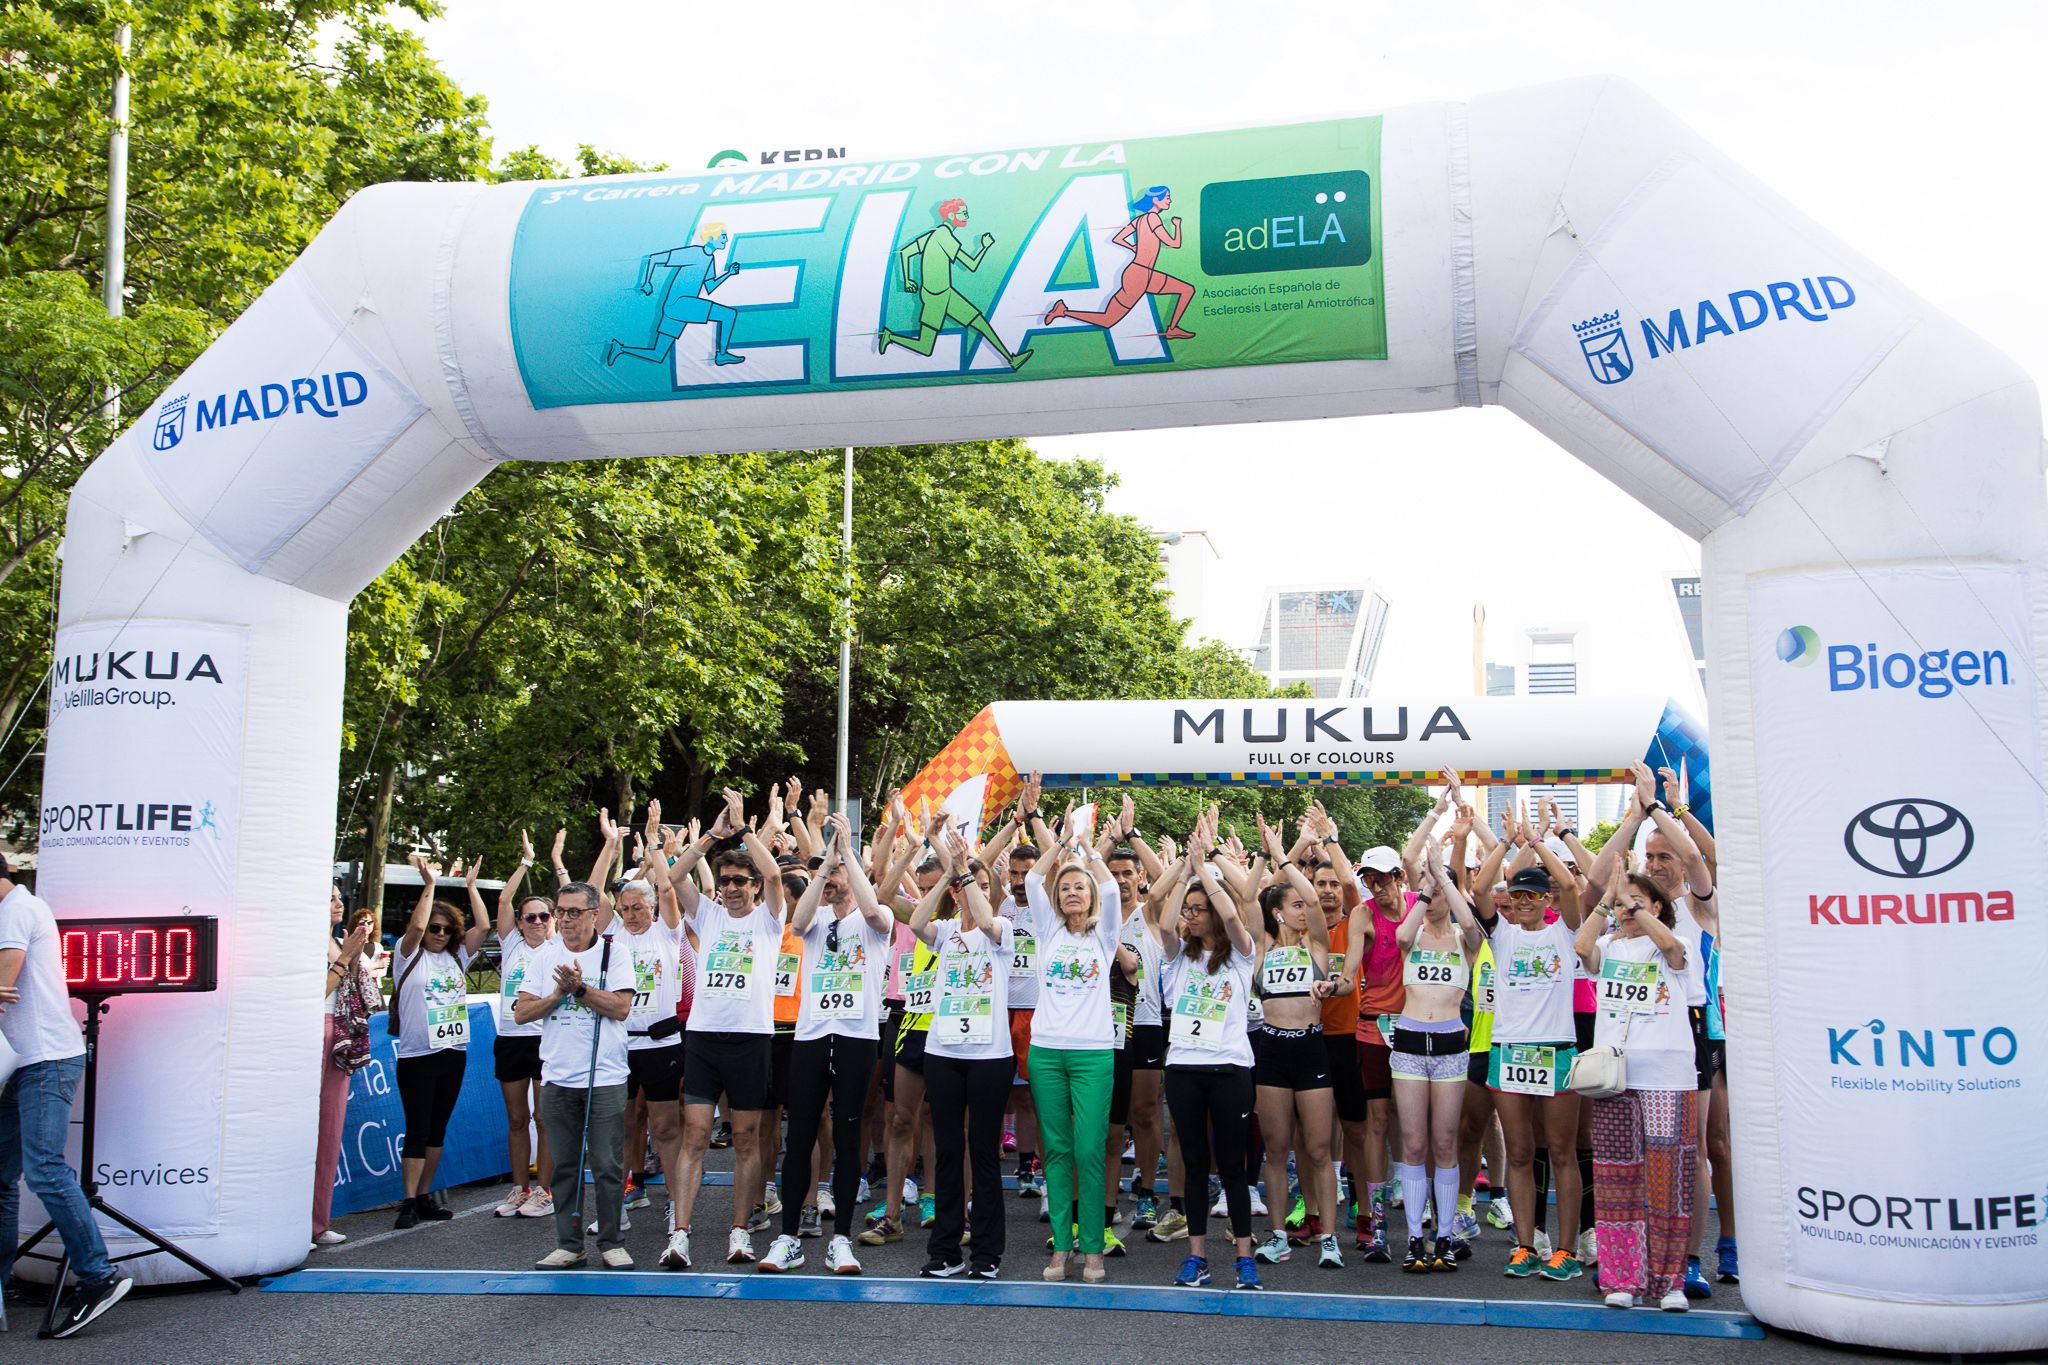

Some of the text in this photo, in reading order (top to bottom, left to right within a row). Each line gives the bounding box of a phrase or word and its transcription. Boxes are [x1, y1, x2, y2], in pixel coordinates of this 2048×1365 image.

[583, 180, 701, 202] Carrera
[710, 160, 922, 197] MADRID
[933, 145, 1055, 178] CON
[1060, 142, 1128, 171] LA
[1224, 213, 1347, 253] adELA
[672, 169, 1174, 391] ELA
[1202, 279, 1341, 299] Asociación Española de
[1203, 296, 1375, 316] Esclerosis Lateral Amiotrófica
[1640, 275, 1857, 359] MADRID
[196, 371, 369, 433] MADRID
[54, 650, 224, 688] MUKUA
[1173, 706, 1472, 744] MUKUA
[1249, 751, 1395, 765] FULL OF COLOURS
[133, 836, 140, 846] Y
[142, 836, 190, 847] EVENTOS
[707, 972, 746, 989] 1278
[1268, 967, 1308, 984] 1767
[1418, 966, 1452, 982] 828
[1613, 965, 1649, 981] ELA
[822, 977, 852, 990] ELA
[1605, 981, 1649, 1002] 1198
[820, 993, 854, 1009] 698
[949, 1001, 980, 1014] ELA
[437, 1022, 463, 1039] 640
[960, 1018, 970, 1034] 3
[1190, 1020, 1201, 1036] 2
[1277, 1029, 1307, 1039] PRO
[1512, 1050, 1543, 1064] ELA
[1506, 1066, 1548, 1084] 1012
[1831, 1076, 2022, 1094] Flexible Mobility Solutions
[97, 1163, 209, 1187] Services
[1800, 1224, 2038, 1250] MOVILIDAD, COMUNICACIÓN Y EVENTOS
